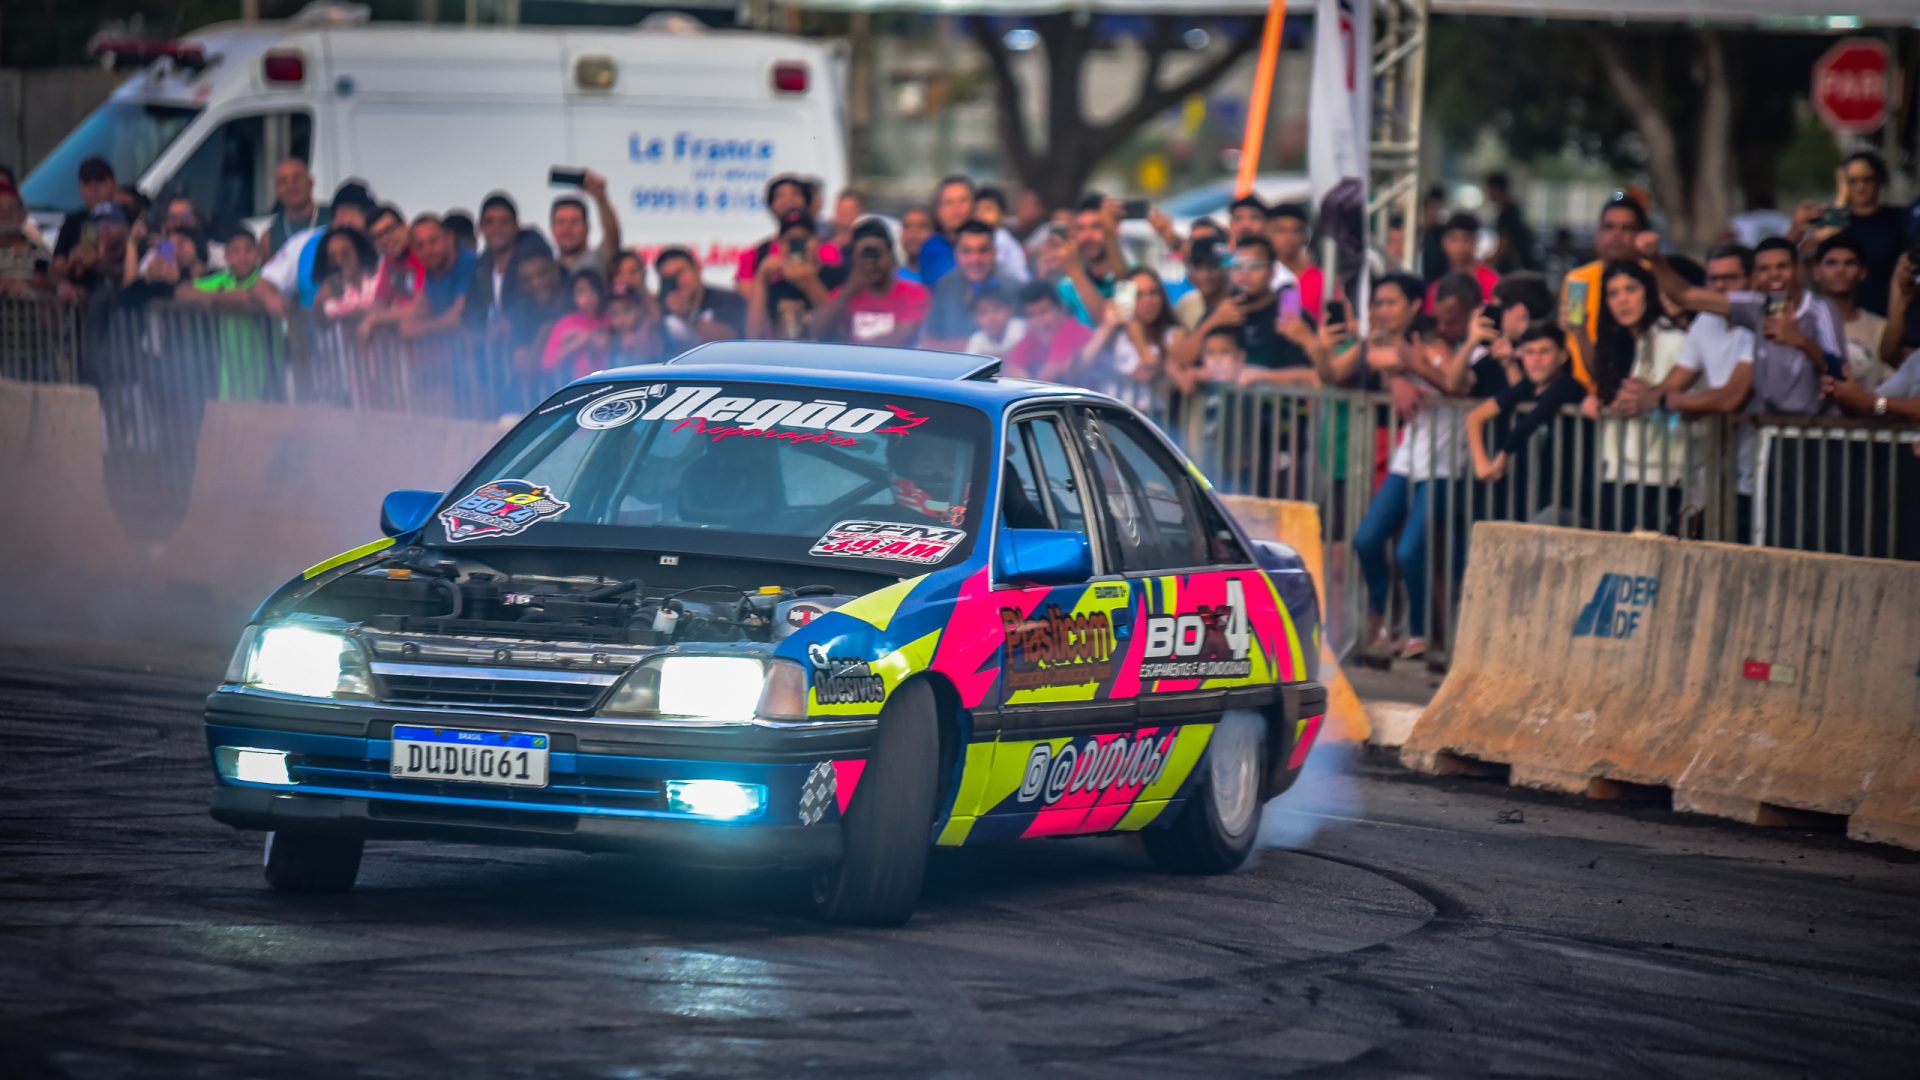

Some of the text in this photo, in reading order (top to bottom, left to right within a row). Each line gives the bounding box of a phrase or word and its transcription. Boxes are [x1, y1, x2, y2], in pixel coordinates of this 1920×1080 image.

[629, 131, 773, 162] Le France
[672, 417, 861, 447] Preparações
[1619, 576, 1658, 607] DER
[1613, 611, 1640, 639] DF
[458, 732, 482, 741] BRASIL
